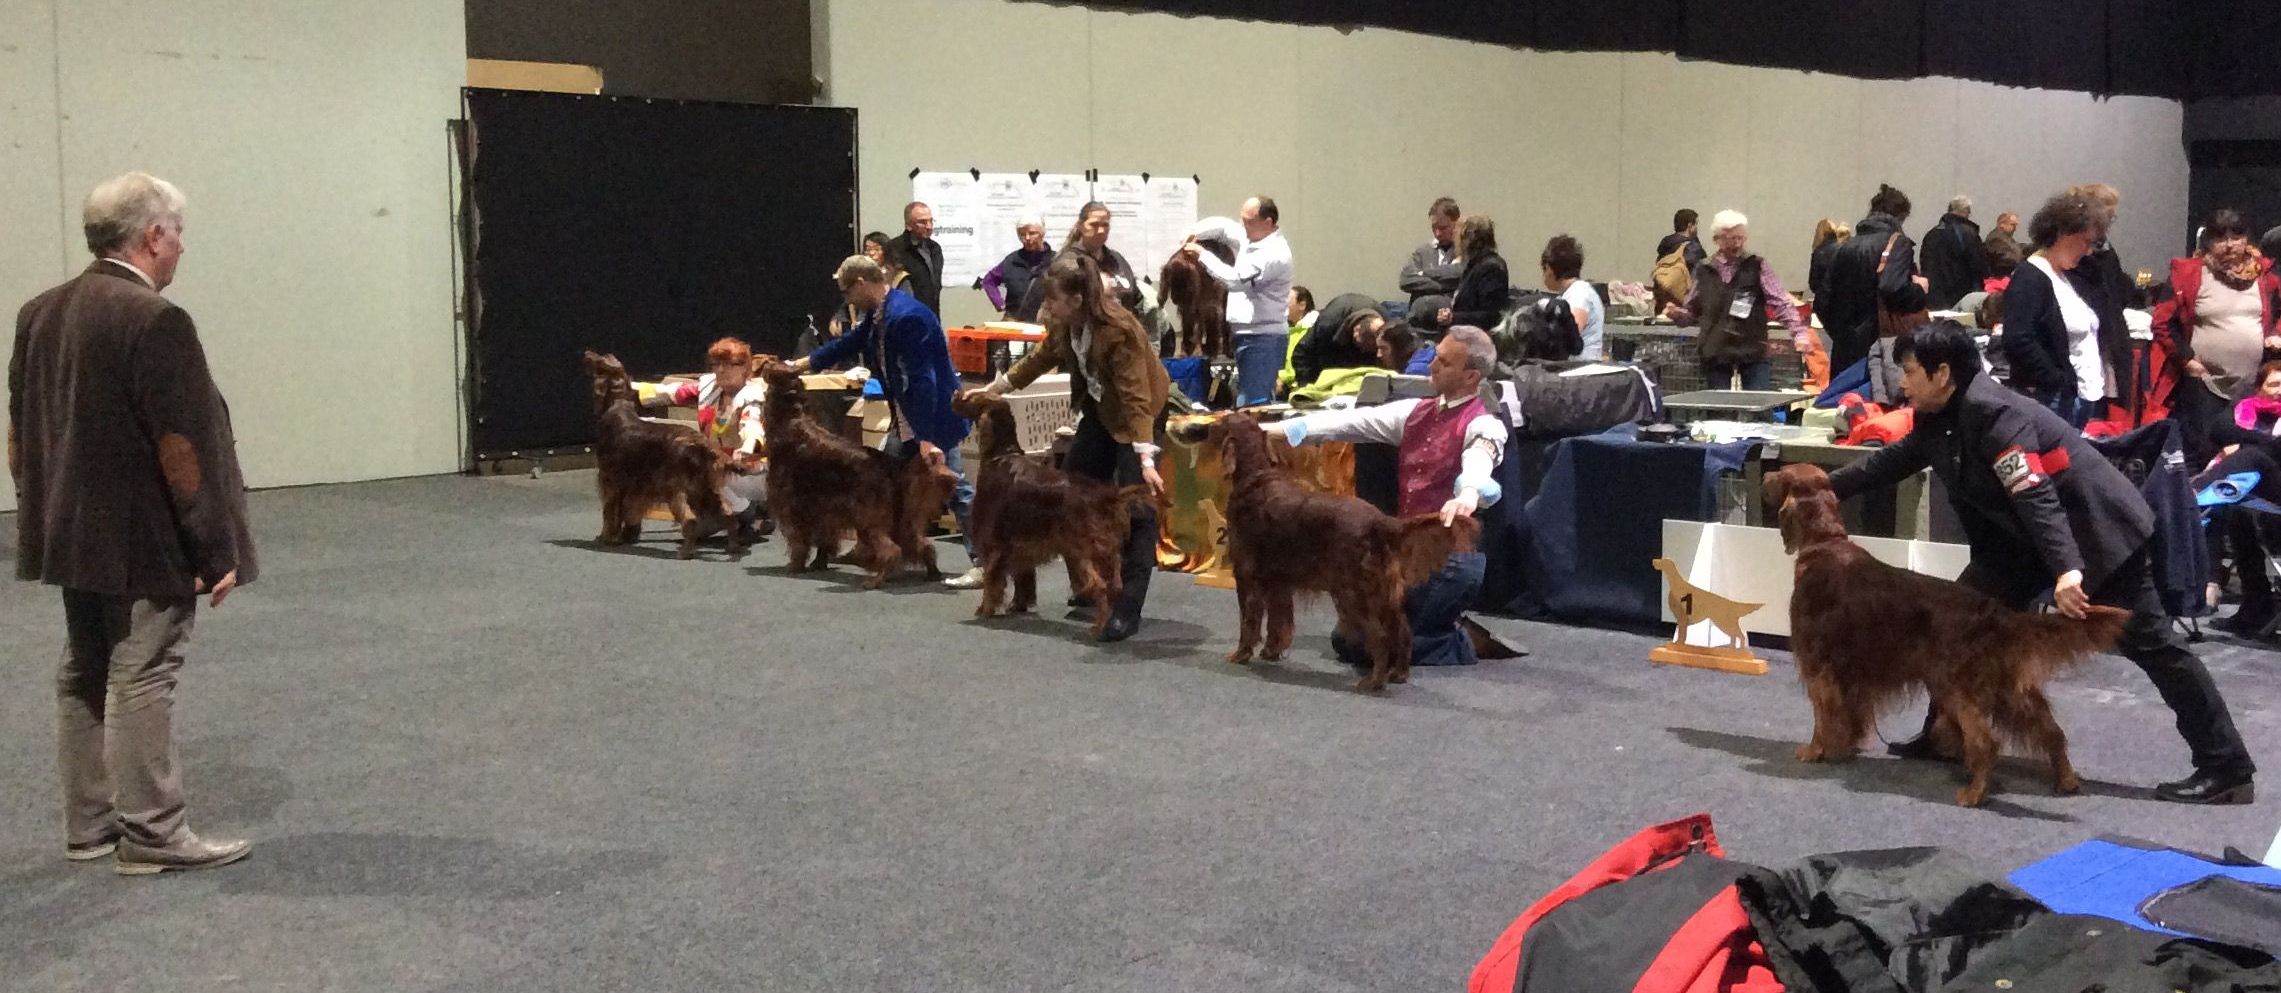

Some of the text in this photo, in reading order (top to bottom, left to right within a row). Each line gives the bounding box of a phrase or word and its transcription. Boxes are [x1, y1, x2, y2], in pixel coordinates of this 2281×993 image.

[933, 225, 974, 236] gtraining
[1216, 527, 1228, 545] 2
[1681, 593, 1692, 615] 1
